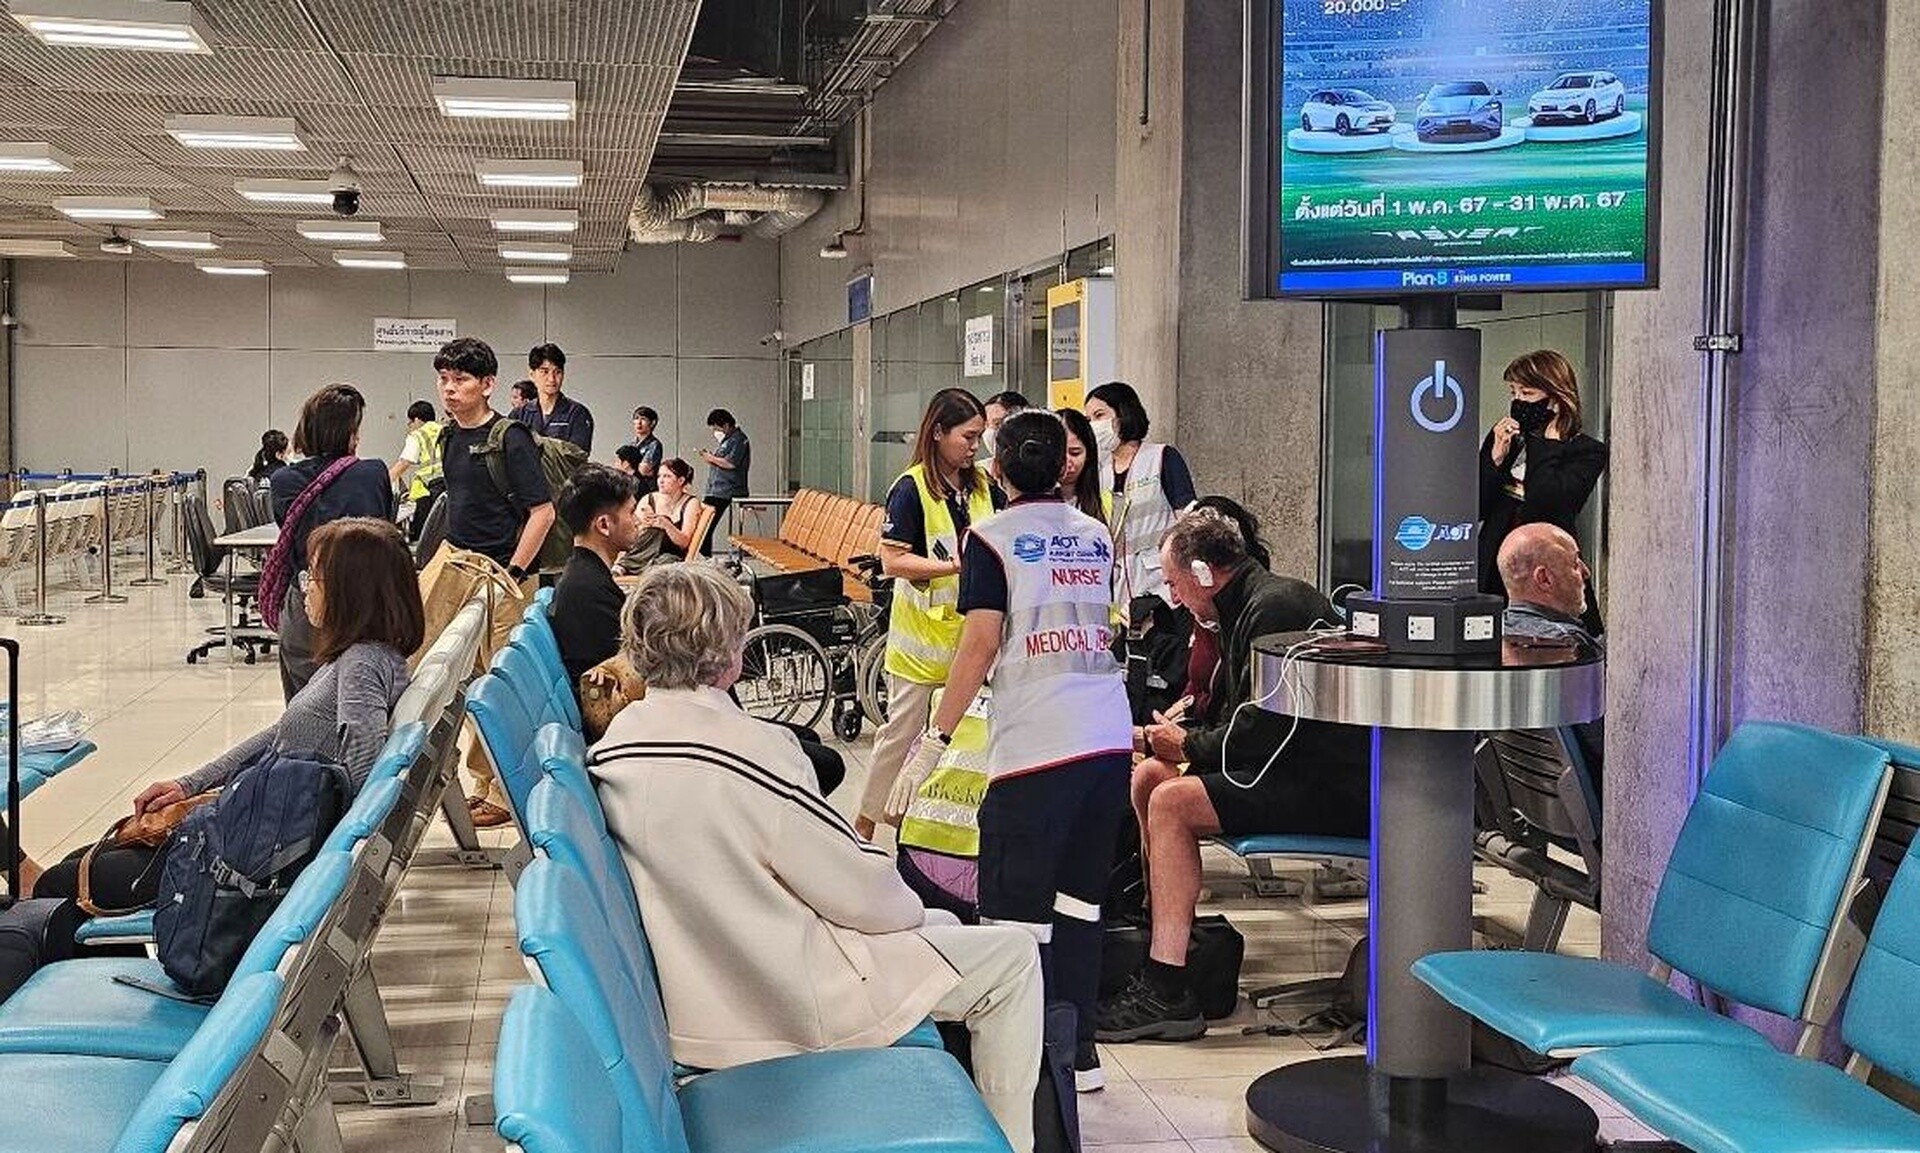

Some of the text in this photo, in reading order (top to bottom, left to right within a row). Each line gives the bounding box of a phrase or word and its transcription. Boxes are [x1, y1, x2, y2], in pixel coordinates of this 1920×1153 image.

[1295, 192, 1385, 220] ตั้งแต่วันที่
[1392, 200, 1401, 216] 1
[1408, 200, 1453, 216] พ.ค.
[1459, 197, 1487, 214] 67
[1509, 194, 1535, 211] 31
[1544, 194, 1591, 211] พ.ค.
[1596, 191, 1626, 208] 67
[1479, 272, 1512, 282] POWER
[1433, 522, 1474, 541] AOT
[1050, 535, 1080, 549] AOT
[1051, 568, 1102, 586] NURSE
[1026, 628, 1093, 658] MEDICAL
